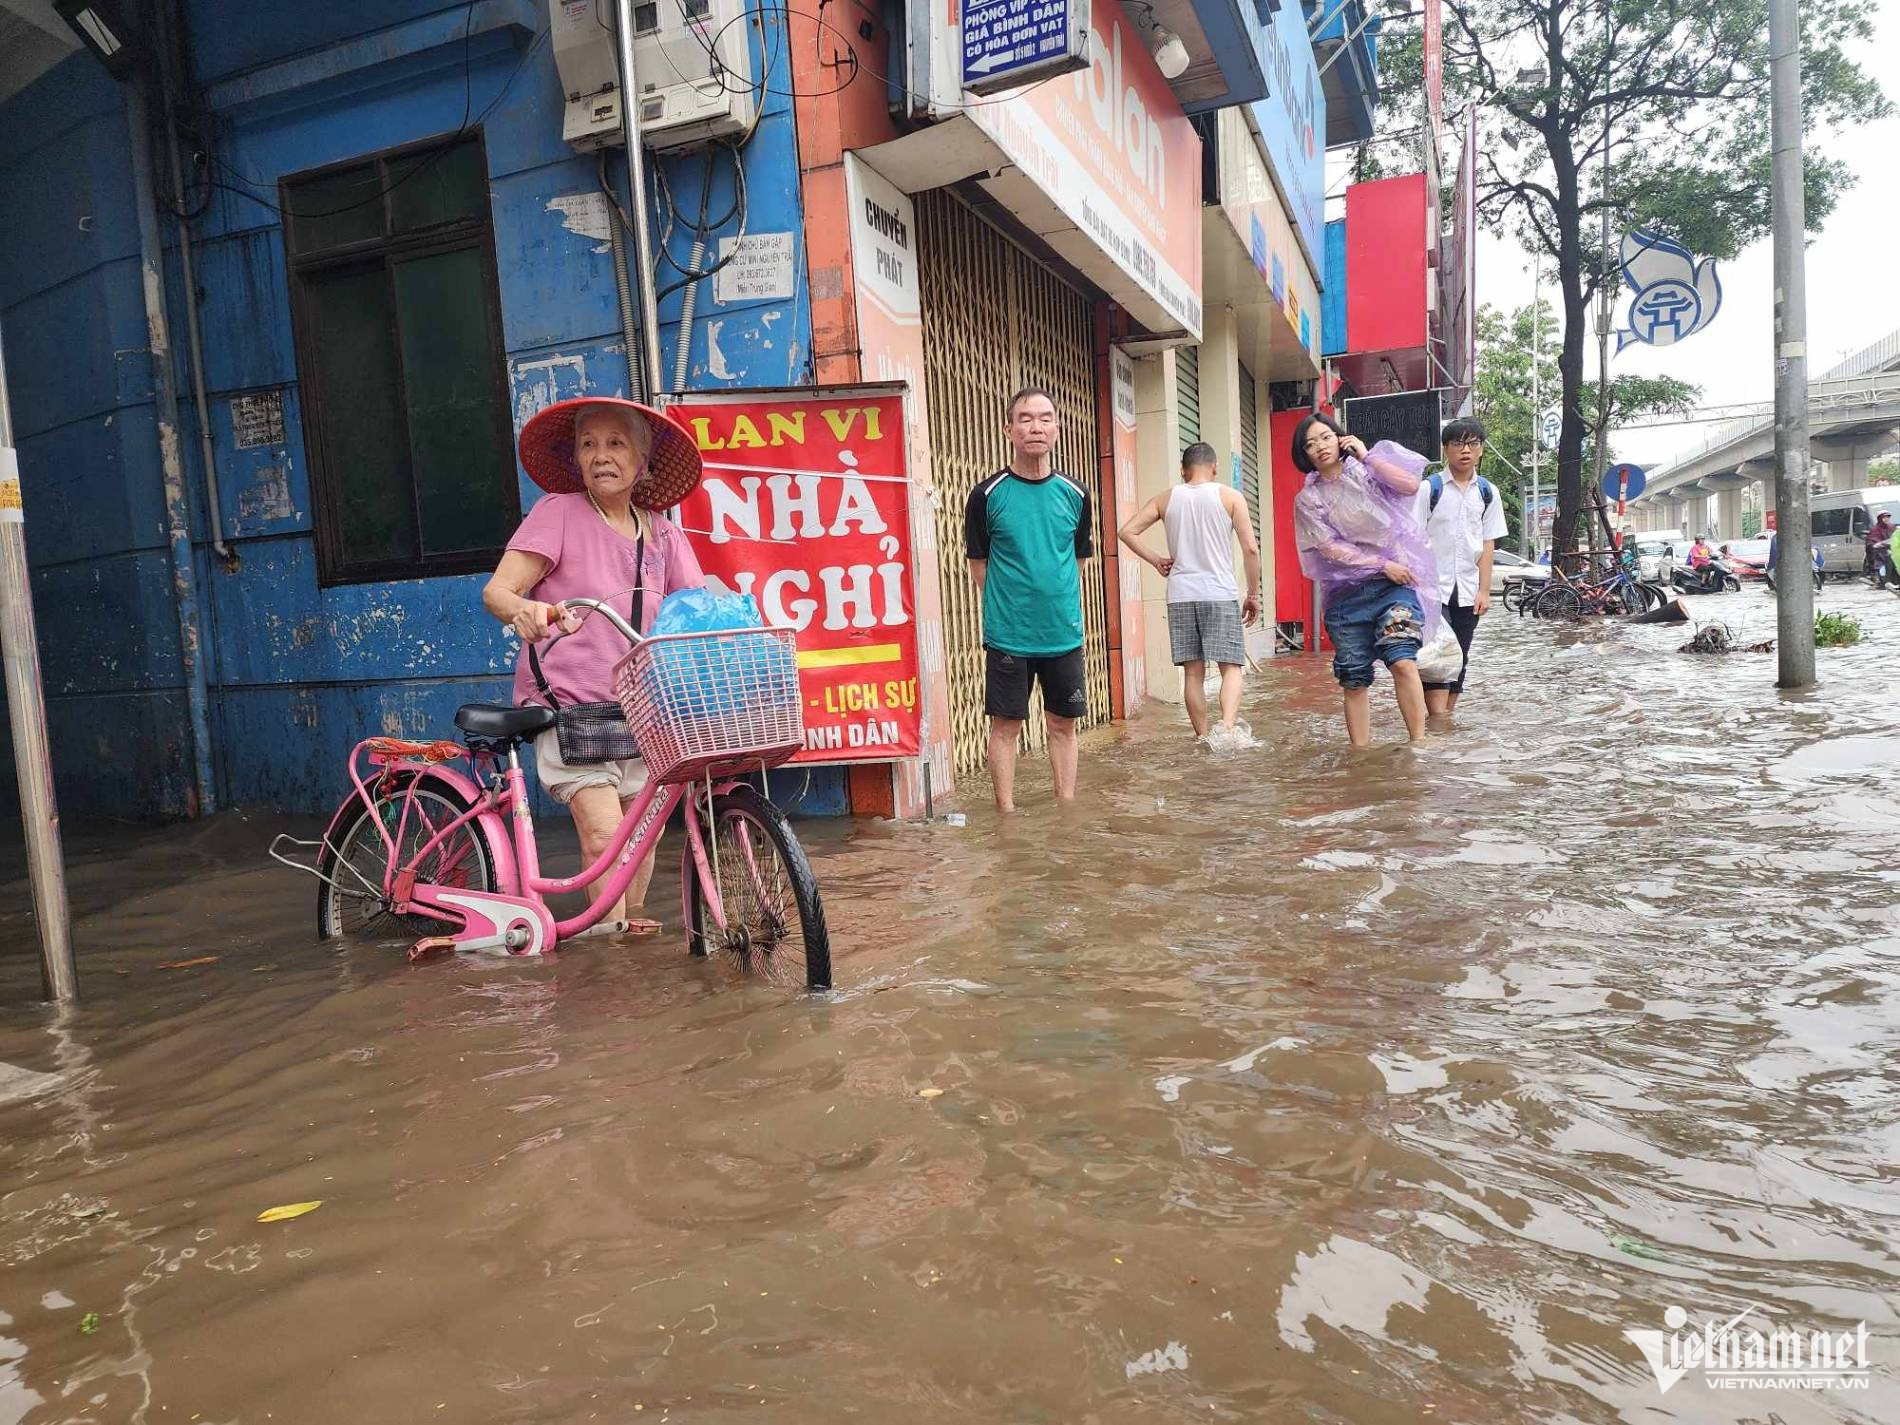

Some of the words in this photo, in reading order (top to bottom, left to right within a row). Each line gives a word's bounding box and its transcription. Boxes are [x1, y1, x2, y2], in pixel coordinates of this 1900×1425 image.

[965, 4, 1007, 29] PHÒNG
[965, 23, 989, 44] GIÁ
[993, 13, 1028, 35] BÌNH
[1033, 0, 1065, 21] DÂN
[966, 41, 982, 58] CÓ
[1012, 27, 1038, 43] ĐƠN
[1041, 17, 1063, 33] VAT
[1074, 20, 1165, 209] alan
[865, 197, 908, 250] CHUYỂN
[876, 247, 904, 288] PHÁT
[690, 411, 806, 450] LAN
[820, 407, 883, 442] VI
[702, 450, 888, 544] NHÀ
[824, 682, 879, 718] LỊCH
[884, 677, 916, 713] SỰ
[848, 717, 899, 748] DÂN
